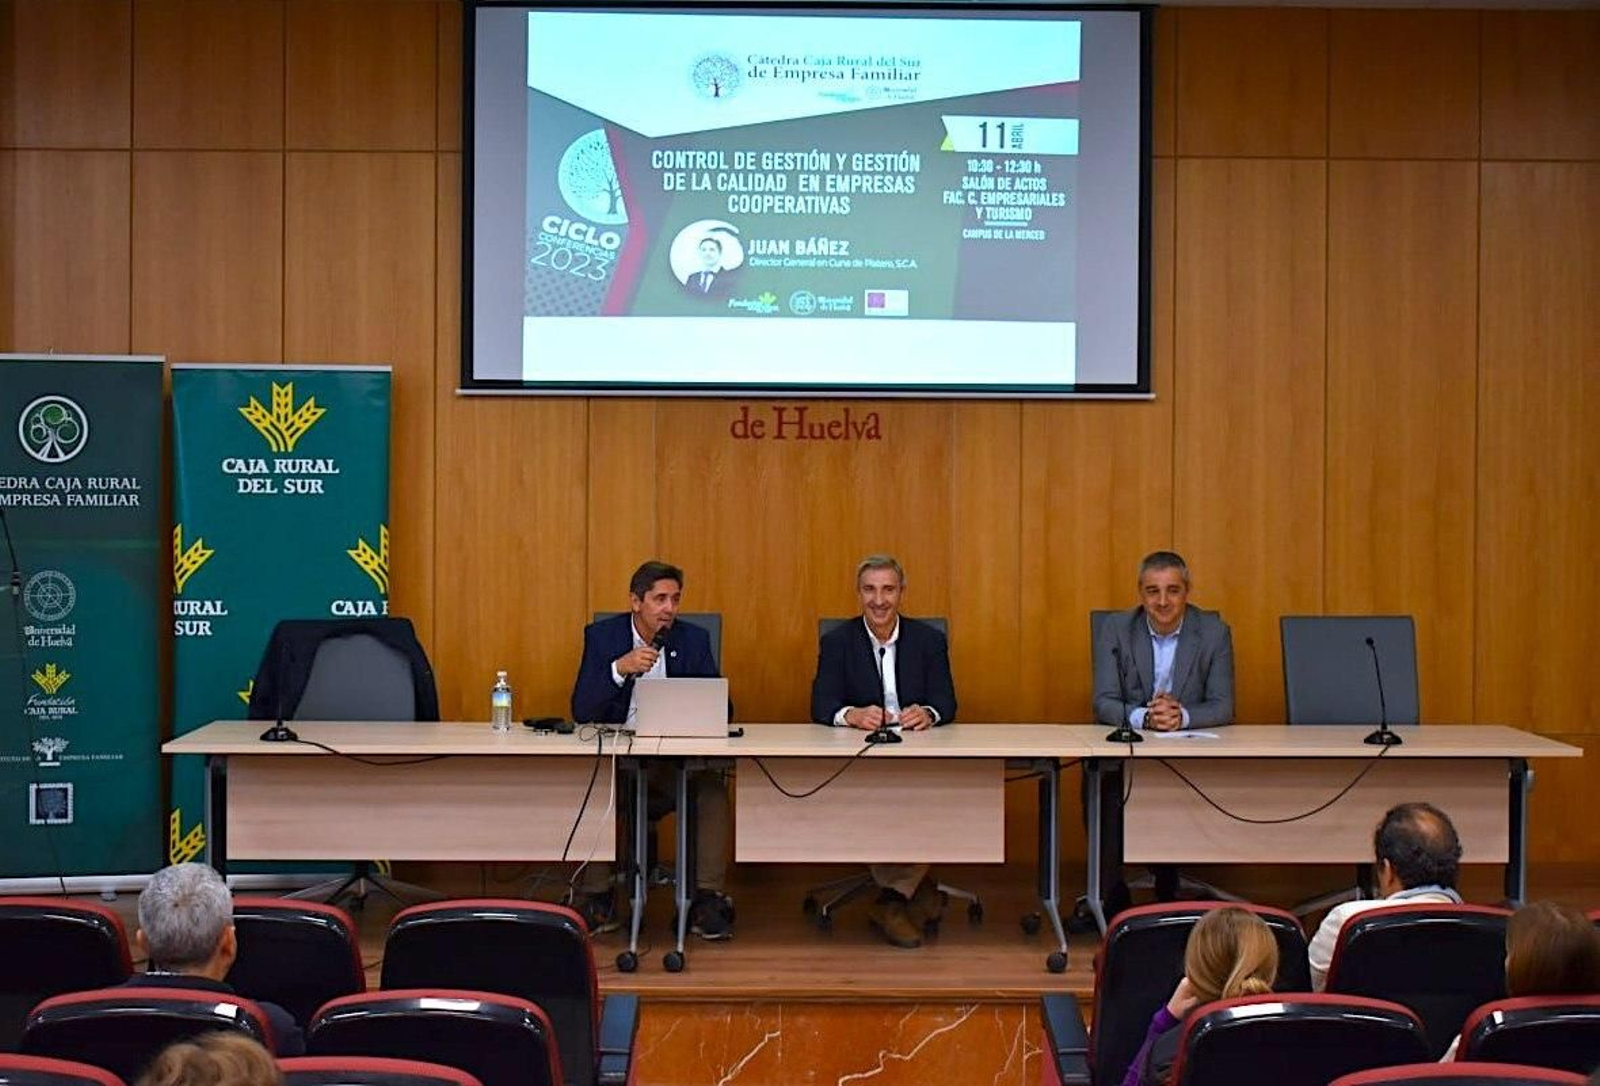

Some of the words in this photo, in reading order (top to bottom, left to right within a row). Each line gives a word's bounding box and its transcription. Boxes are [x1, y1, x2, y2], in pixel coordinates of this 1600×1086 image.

[803, 55, 832, 67] Caja
[837, 56, 873, 66] Rural
[876, 56, 896, 67] del
[899, 57, 921, 67] Sur
[747, 65, 767, 78] de
[773, 66, 844, 83] Empresa
[851, 68, 921, 81] Familiar
[978, 121, 1005, 149] 11
[1011, 123, 1025, 150] ABRIL
[652, 150, 728, 170] CONTROL
[734, 151, 756, 171] DE
[761, 149, 831, 172] GESTIÓN
[835, 153, 847, 172] Y
[852, 150, 920, 173] GESTIÓN
[1034, 160, 1042, 174] h
[663, 172, 686, 191] DE
[691, 173, 712, 192] LA
[716, 173, 787, 192] CALIDAD
[799, 175, 820, 192] EN
[826, 174, 916, 194] EMPRESAS
[962, 175, 995, 190] SALÓN
[997, 177, 1011, 190] DE
[1013, 177, 1047, 191] ACTOS
[727, 194, 851, 215] COOPERATIVAS
[943, 190, 965, 205] FAC.
[967, 191, 978, 205] C.
[981, 192, 1066, 207] EMPRESARIALES
[975, 207, 983, 219] Y
[985, 207, 1032, 221] TURISMO
[541, 215, 621, 250] CICLO
[1004, 229, 1014, 239] LA
[748, 239, 789, 256] JUAN
[795, 236, 850, 256] BÁÑEZ
[530, 241, 610, 280] 2023
[730, 406, 765, 440] de
[772, 406, 882, 441] Huelva
[222, 458, 270, 475] CAJA
[273, 458, 340, 474] RURAL
[45, 477, 82, 493] CAJA
[88, 477, 141, 490] RURAL
[237, 478, 278, 494] DEL
[283, 478, 325, 494] SUR
[66, 494, 140, 507] FAMILIAR
[331, 600, 378, 617] CAJA
[174, 620, 212, 636] SUR
[28, 636, 40, 647] de
[41, 636, 73, 648] Huelva
